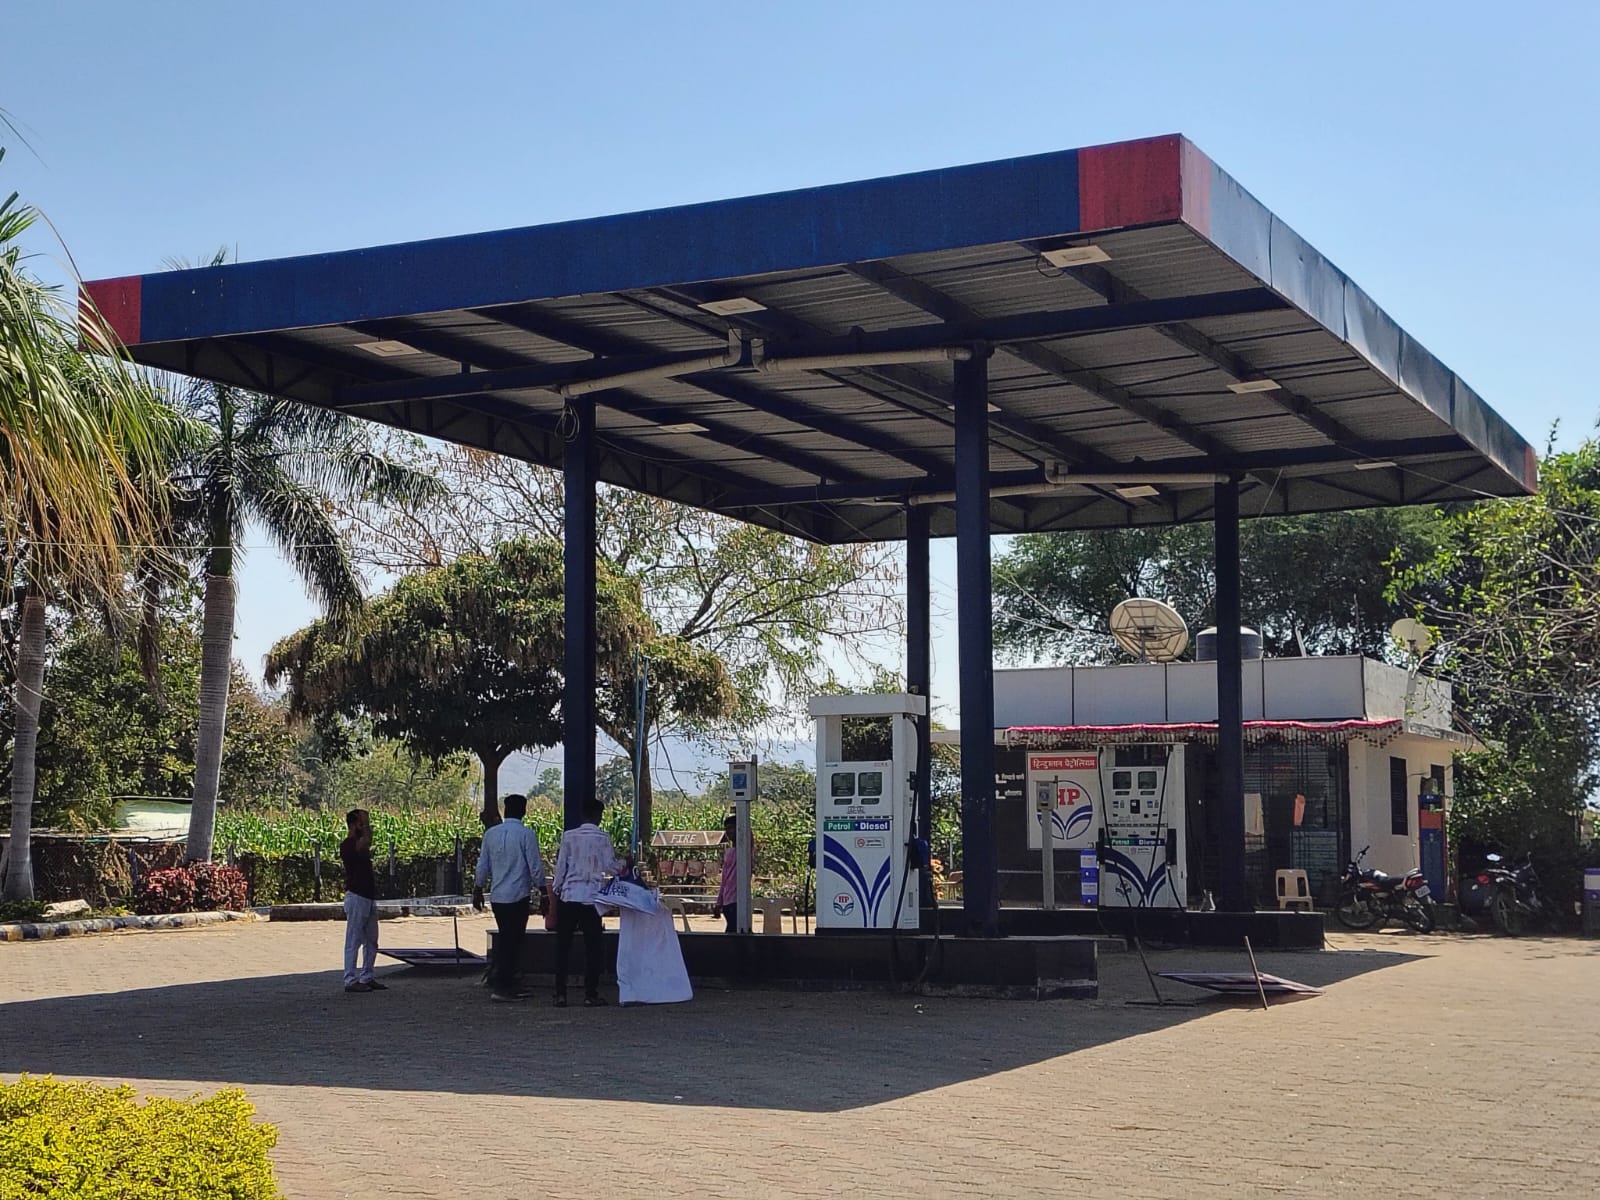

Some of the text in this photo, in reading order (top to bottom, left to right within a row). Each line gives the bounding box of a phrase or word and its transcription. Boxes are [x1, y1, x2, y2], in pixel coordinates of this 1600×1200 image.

[828, 821, 888, 830] Petrol Diesel
[670, 834, 697, 844] FIRE
